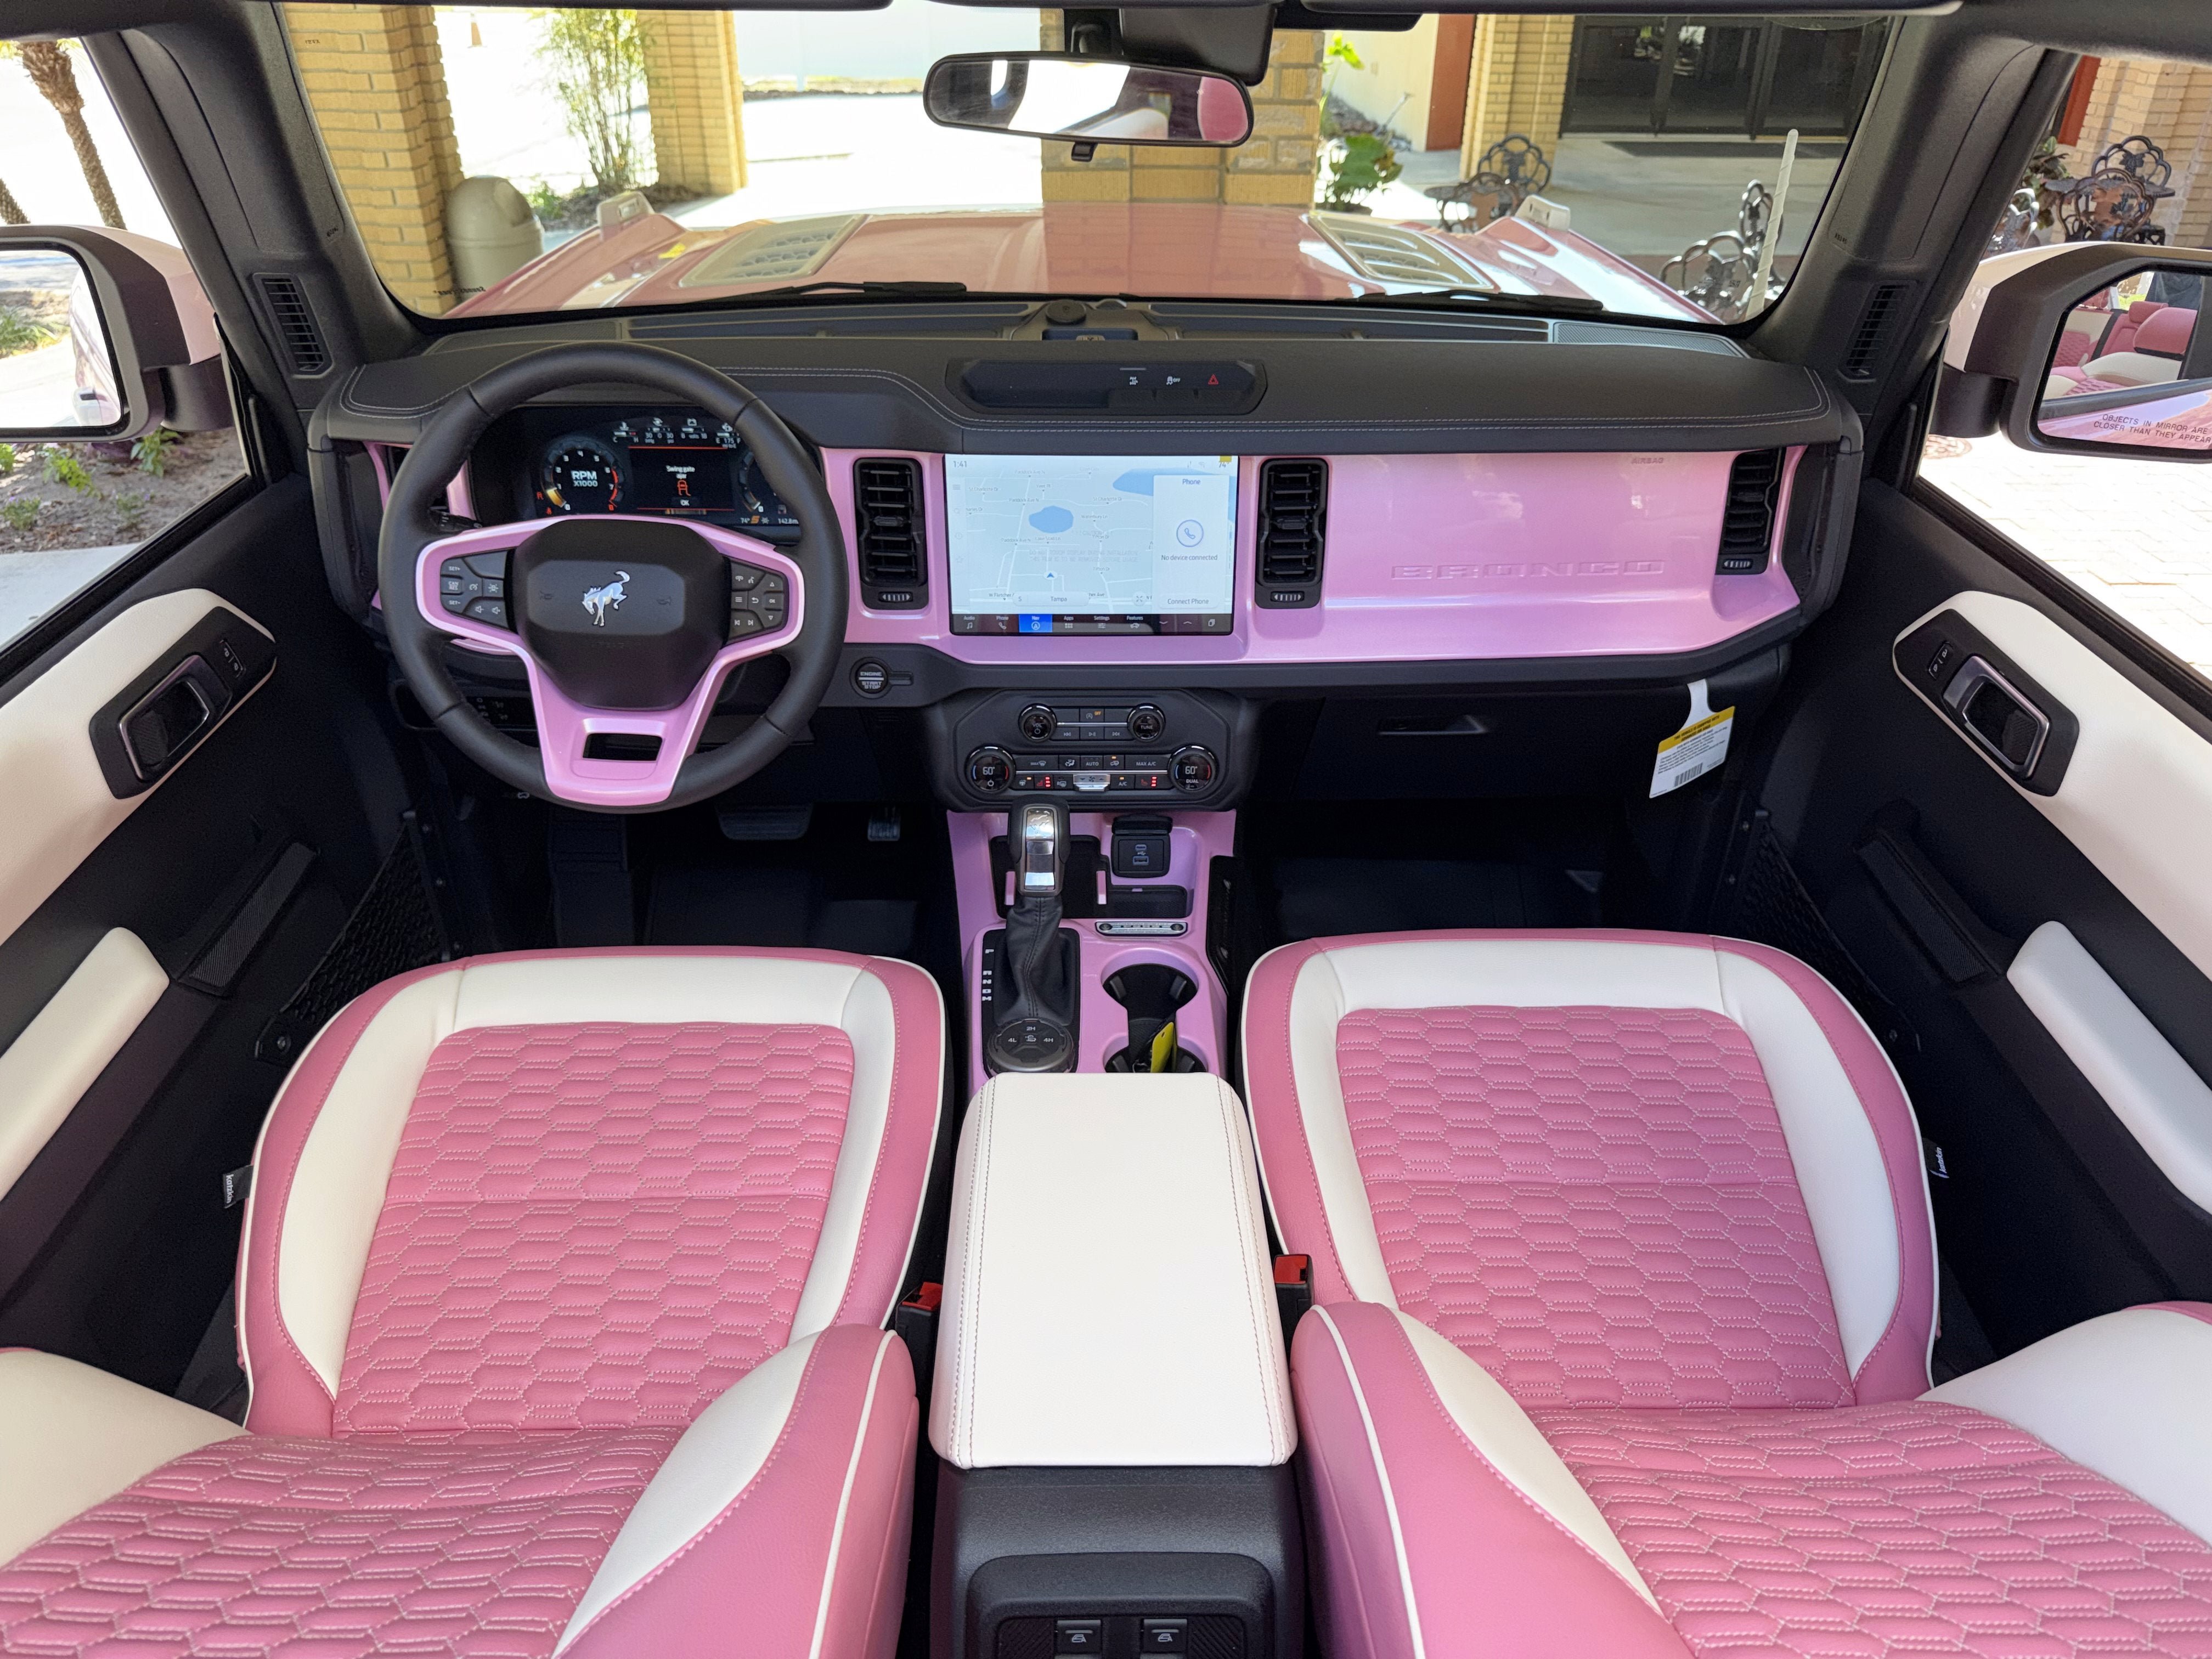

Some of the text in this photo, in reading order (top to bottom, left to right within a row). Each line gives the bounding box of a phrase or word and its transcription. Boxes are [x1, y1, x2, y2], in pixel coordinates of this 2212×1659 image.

[2093, 421, 2212, 444] CLOSER THAN THEY APPEAR
[2102, 414, 2139, 425] OBJECTS
[2155, 421, 2188, 432] MIRROR
[571, 470, 597, 480] RPM
[1391, 560, 1665, 580] BRONCO
